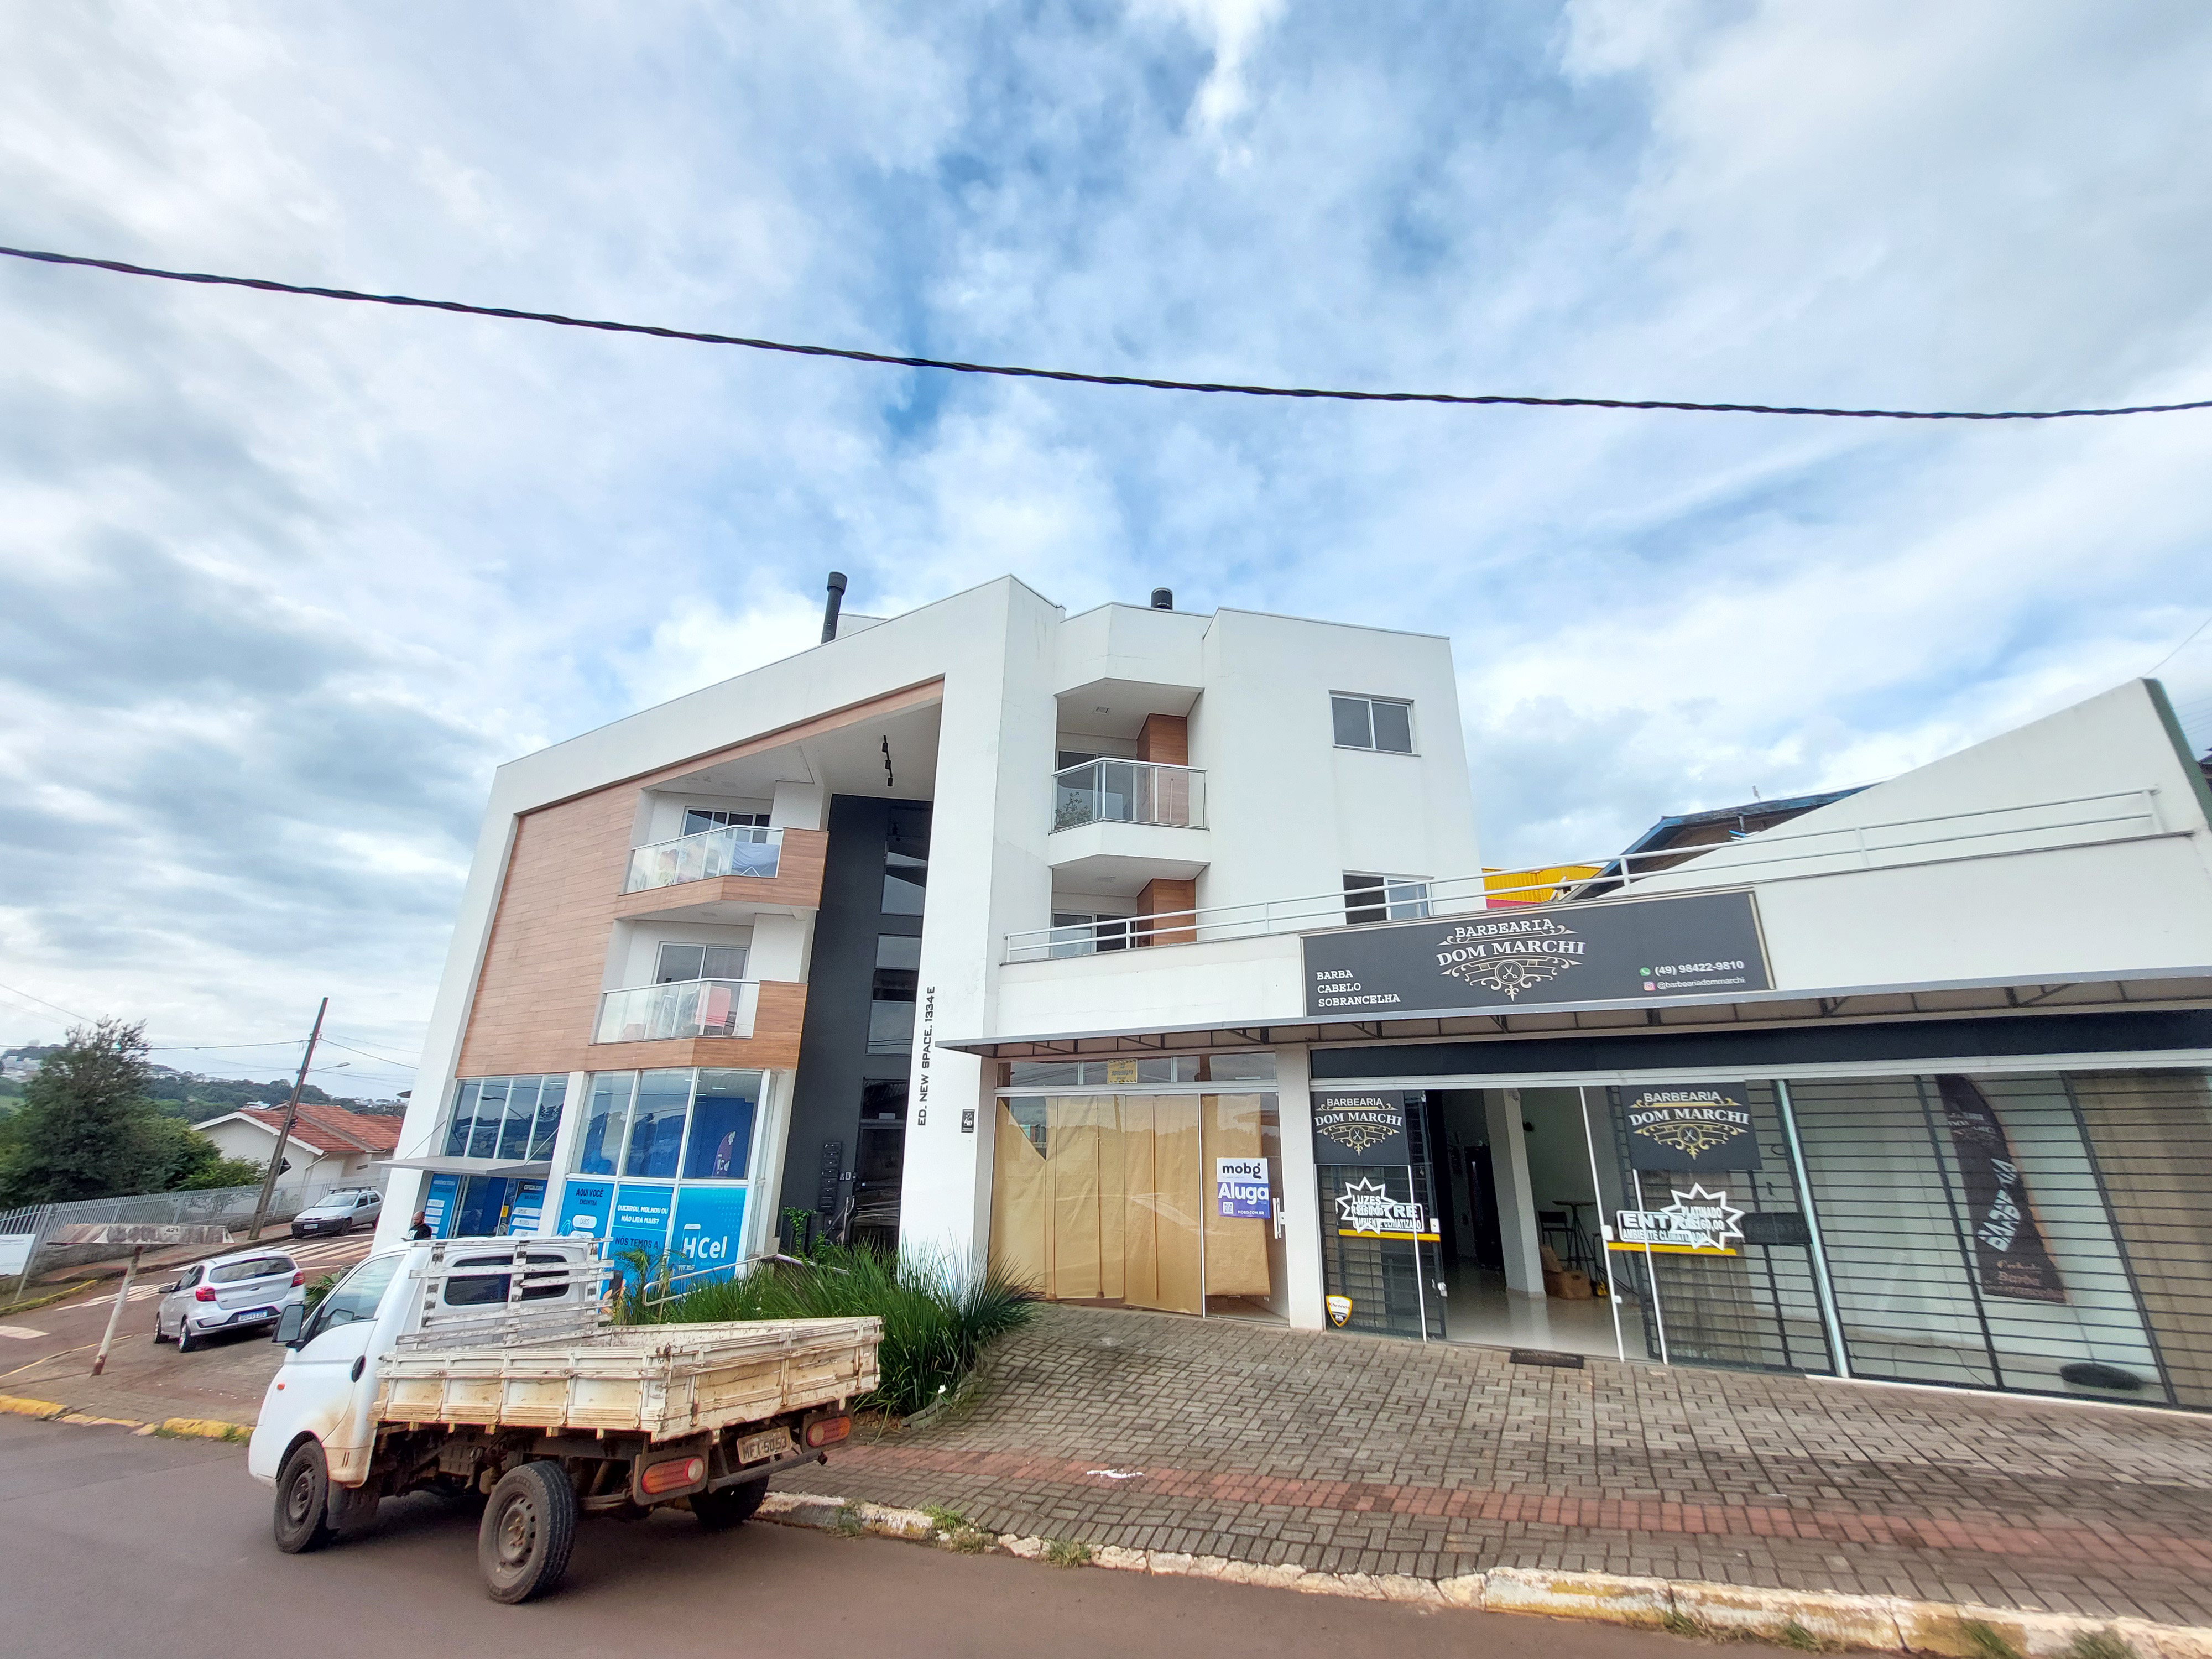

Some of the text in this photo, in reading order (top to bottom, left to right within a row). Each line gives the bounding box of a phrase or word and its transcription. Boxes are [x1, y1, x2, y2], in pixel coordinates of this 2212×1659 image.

[1454, 919, 1555, 938] BARBEARIA
[1436, 940, 1586, 966] DOM MARCHI
[1316, 969, 1354, 980] BARBA
[1655, 961, 1745, 977] (49) 98422-9810
[1317, 983, 1361, 994] CABELO
[1657, 977, 1746, 990] @barbeariadommarchi
[1318, 994, 1401, 1008] SOBRANCELHA
[920, 1074, 929, 1102] NEW
[1327, 1098, 1384, 1107] BARBEARIA
[1643, 1091, 1723, 1103] BARBEARIA
[918, 1105, 927, 1126] ED.
[1314, 1112, 1403, 1126] DOM MARCHI
[1628, 1108, 1750, 1126] DOM MARCHI
[576, 1187, 604, 1198] AQUI VOCÊ
[1218, 1182, 1269, 1204] Aluga
[1352, 1194, 1381, 1206] LUZES
[640, 1206, 661, 1214] MOLHOU
[1681, 1206, 1723, 1219] PLATINADO
[621, 1214, 632, 1223] NÃO
[644, 1217, 659, 1225] MAIS?
[1384, 1218, 1421, 1229] CLIMATIZAO
[615, 1235, 659, 1249] NÓS TEMOS A
[682, 1235, 728, 1259] HCel
